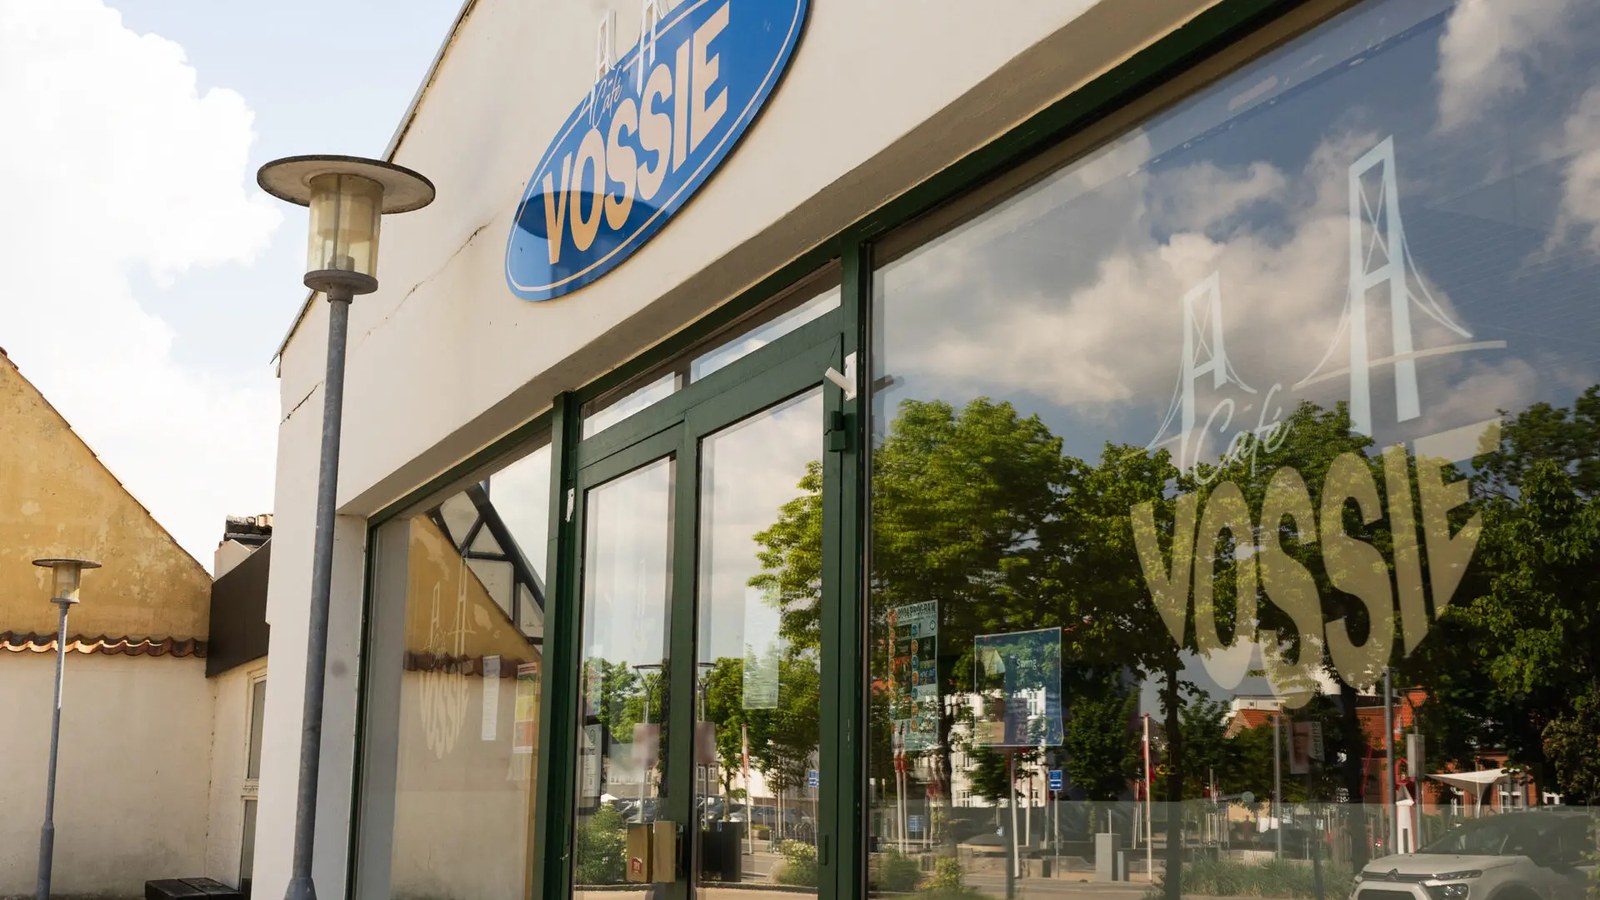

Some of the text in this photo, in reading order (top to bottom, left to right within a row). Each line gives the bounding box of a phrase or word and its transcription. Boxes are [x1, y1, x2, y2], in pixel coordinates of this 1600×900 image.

[542, 1, 730, 264] VOSSIE
[592, 64, 623, 127] Café
[1193, 383, 1292, 485] Café
[1130, 418, 1502, 709] VOSSIE
